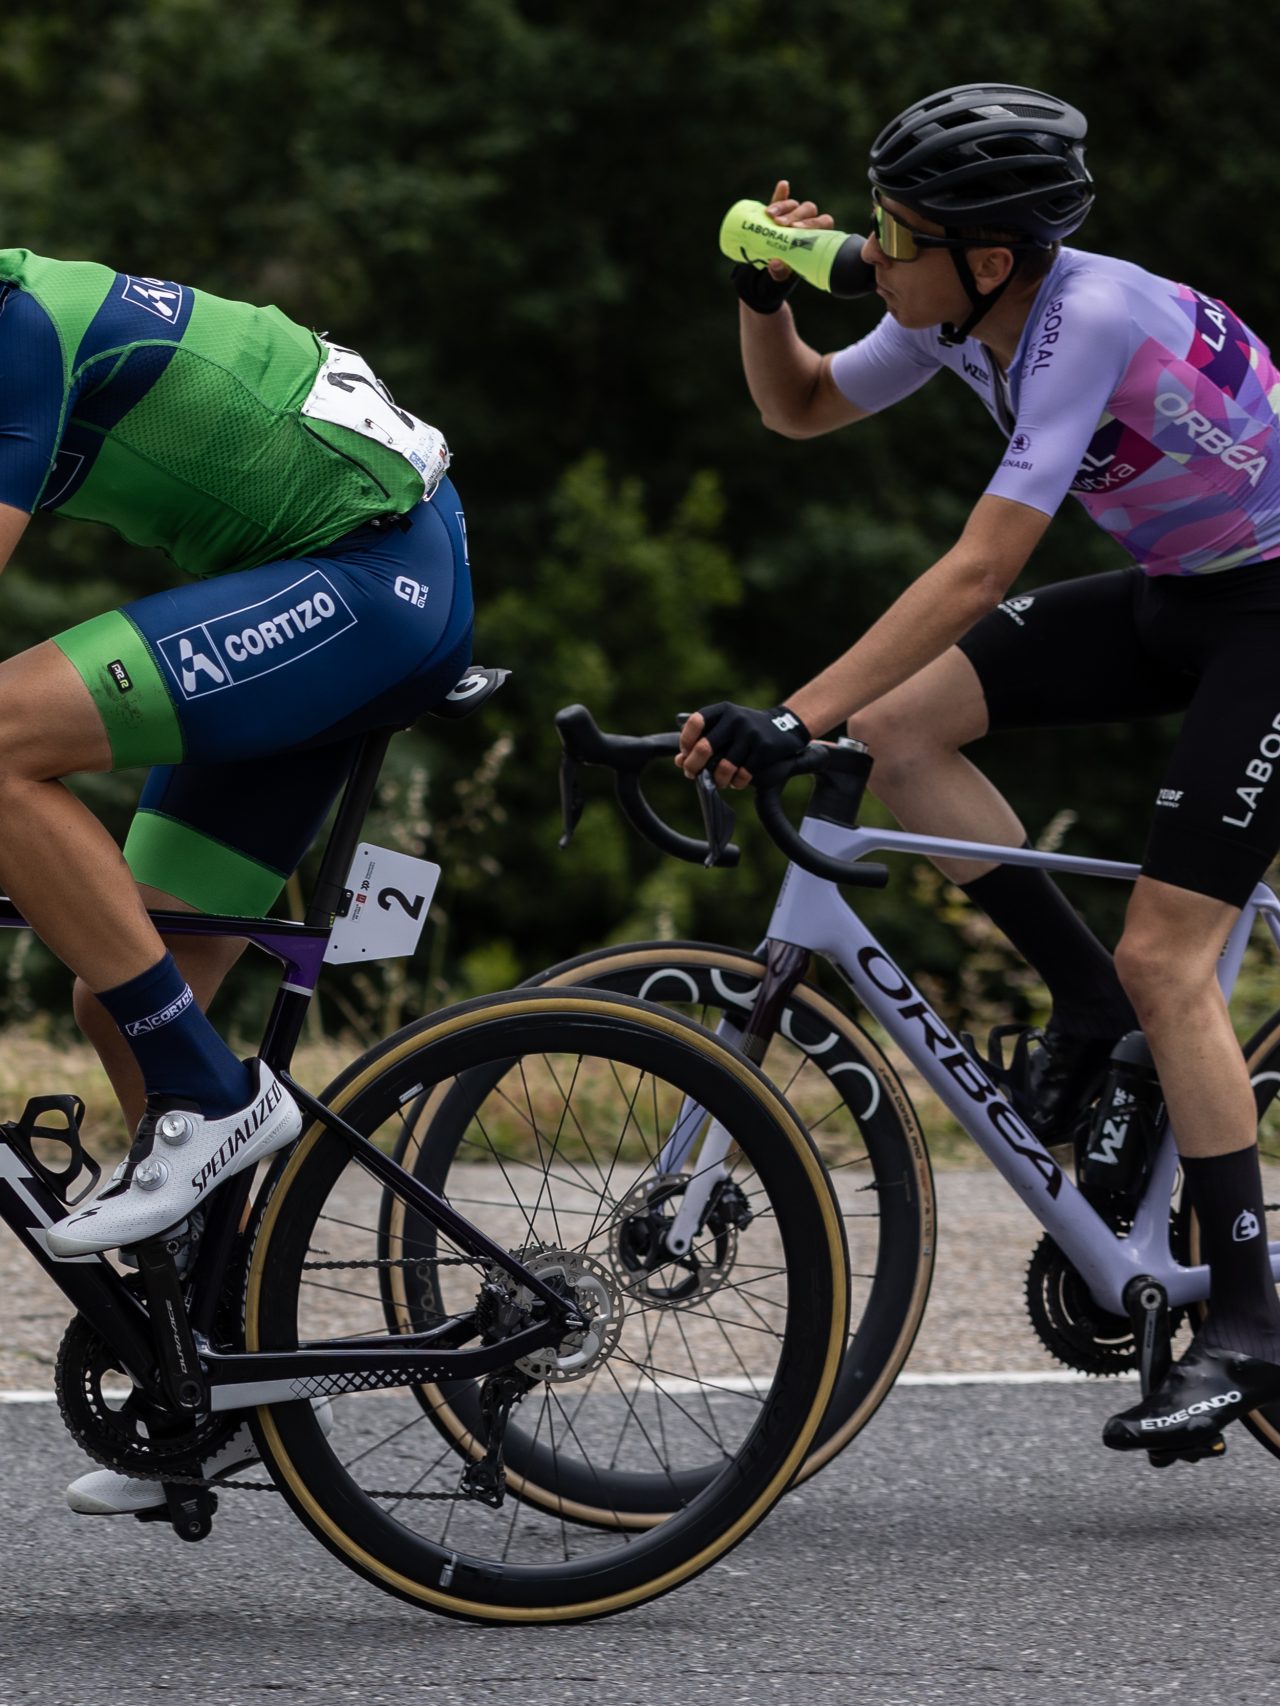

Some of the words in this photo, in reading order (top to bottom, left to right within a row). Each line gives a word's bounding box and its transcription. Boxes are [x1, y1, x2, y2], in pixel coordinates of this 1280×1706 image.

[741, 220, 790, 244] LABORAL
[1153, 392, 1269, 488] ORBEA
[223, 591, 337, 662] CORTIZO
[377, 886, 426, 921] 2
[856, 946, 1063, 1201] ORBEA
[191, 1078, 283, 1200] SPECIALIZED
